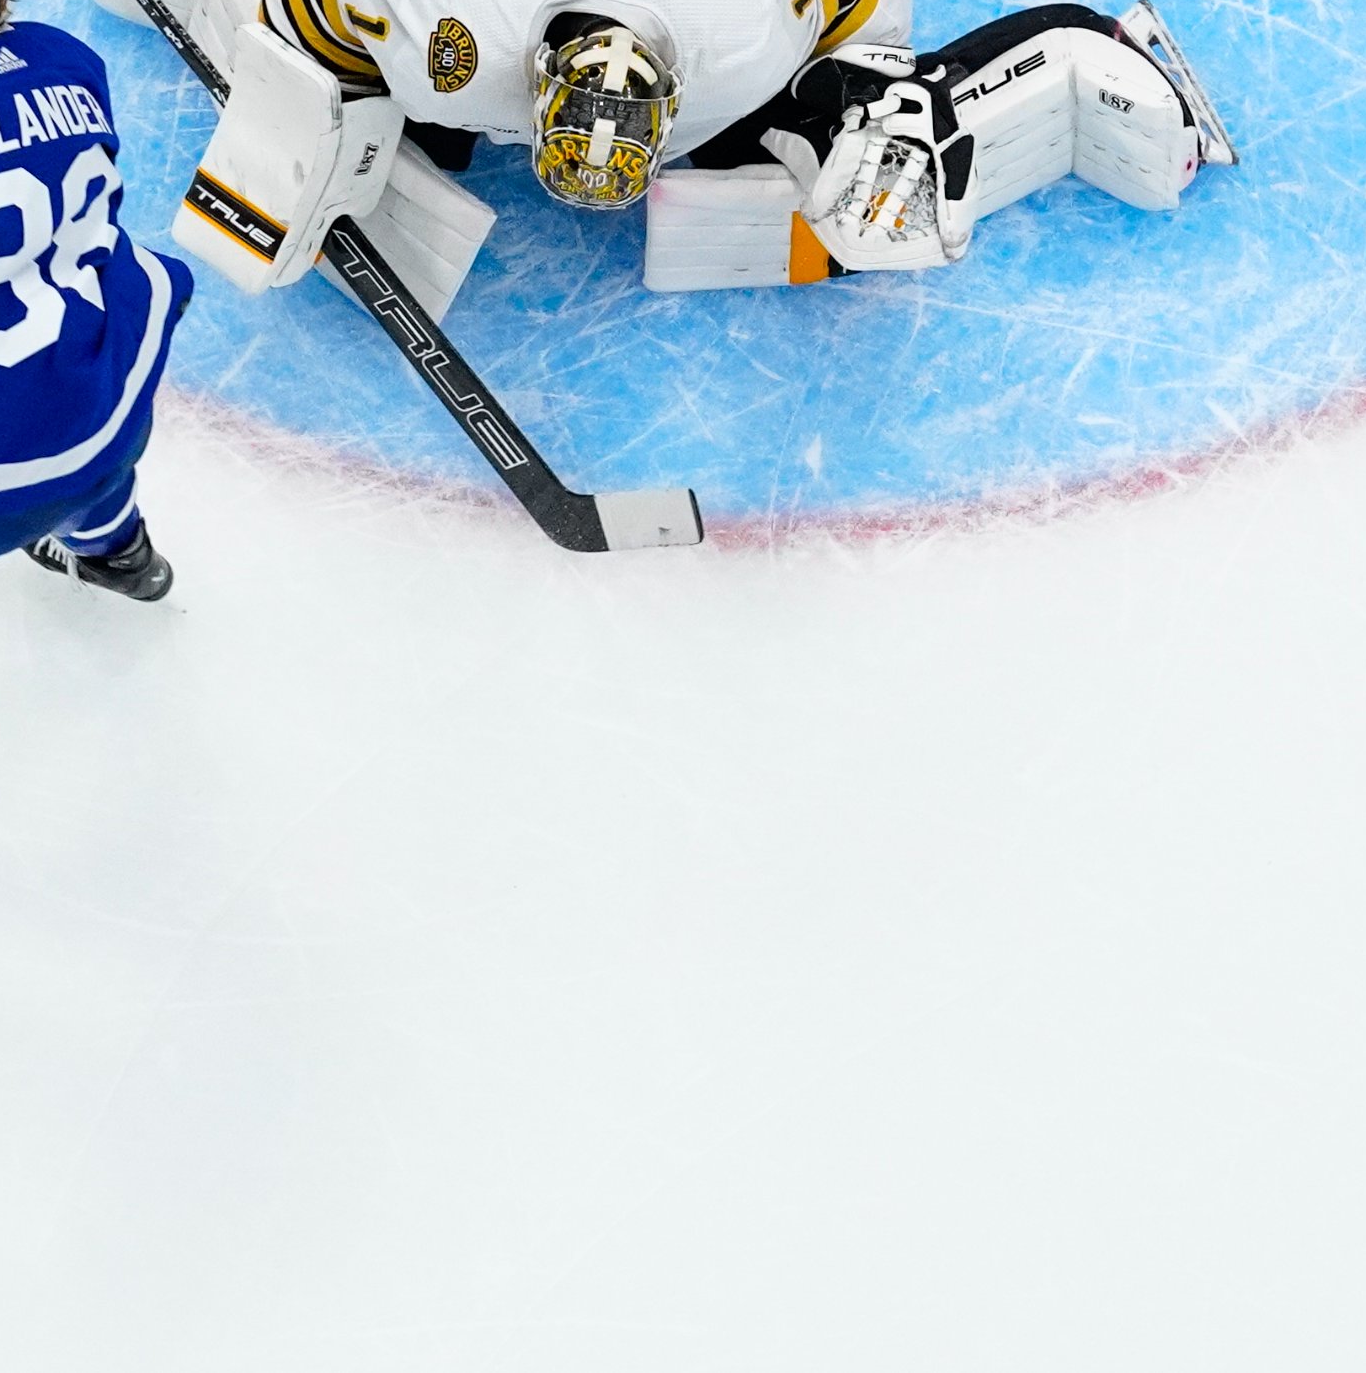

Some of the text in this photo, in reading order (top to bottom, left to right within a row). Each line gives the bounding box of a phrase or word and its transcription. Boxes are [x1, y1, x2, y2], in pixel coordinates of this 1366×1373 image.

[441, 46, 456, 68] 100
[447, 24, 473, 87] BRUINS
[862, 52, 916, 68] TRUE
[952, 49, 1047, 107] RUE
[543, 138, 645, 180] BRNS
[194, 183, 276, 248] TRUE
[332, 229, 529, 471] TRUE
